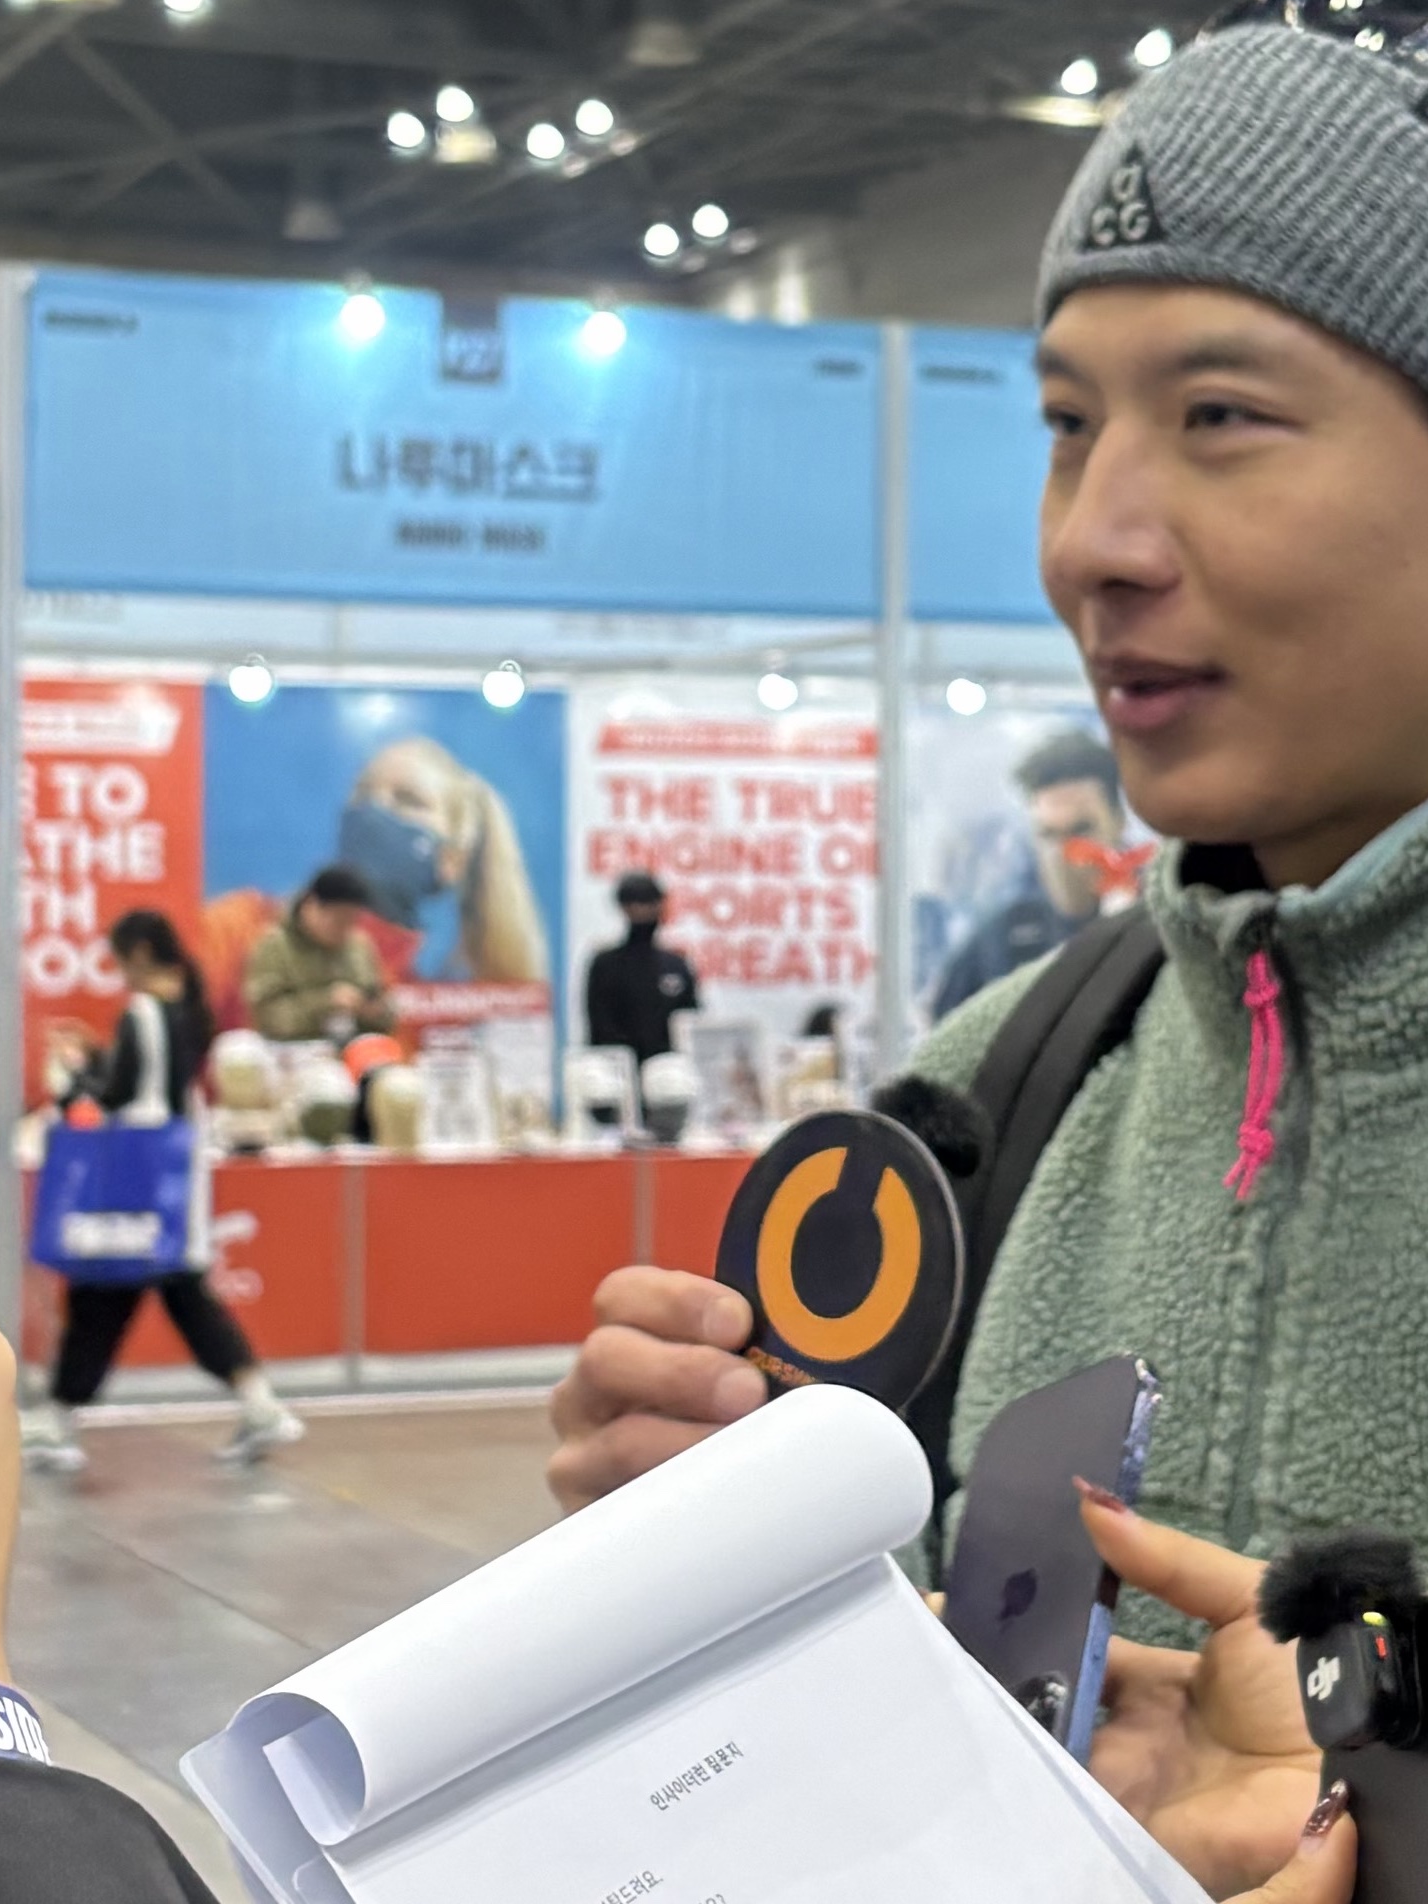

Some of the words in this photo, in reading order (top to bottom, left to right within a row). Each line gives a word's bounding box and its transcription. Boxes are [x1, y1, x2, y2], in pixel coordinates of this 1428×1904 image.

[48, 762, 149, 821] TO
[603, 776, 710, 819] THE
[736, 778, 876, 824] TRUE
[661, 882, 857, 930] PORTS
